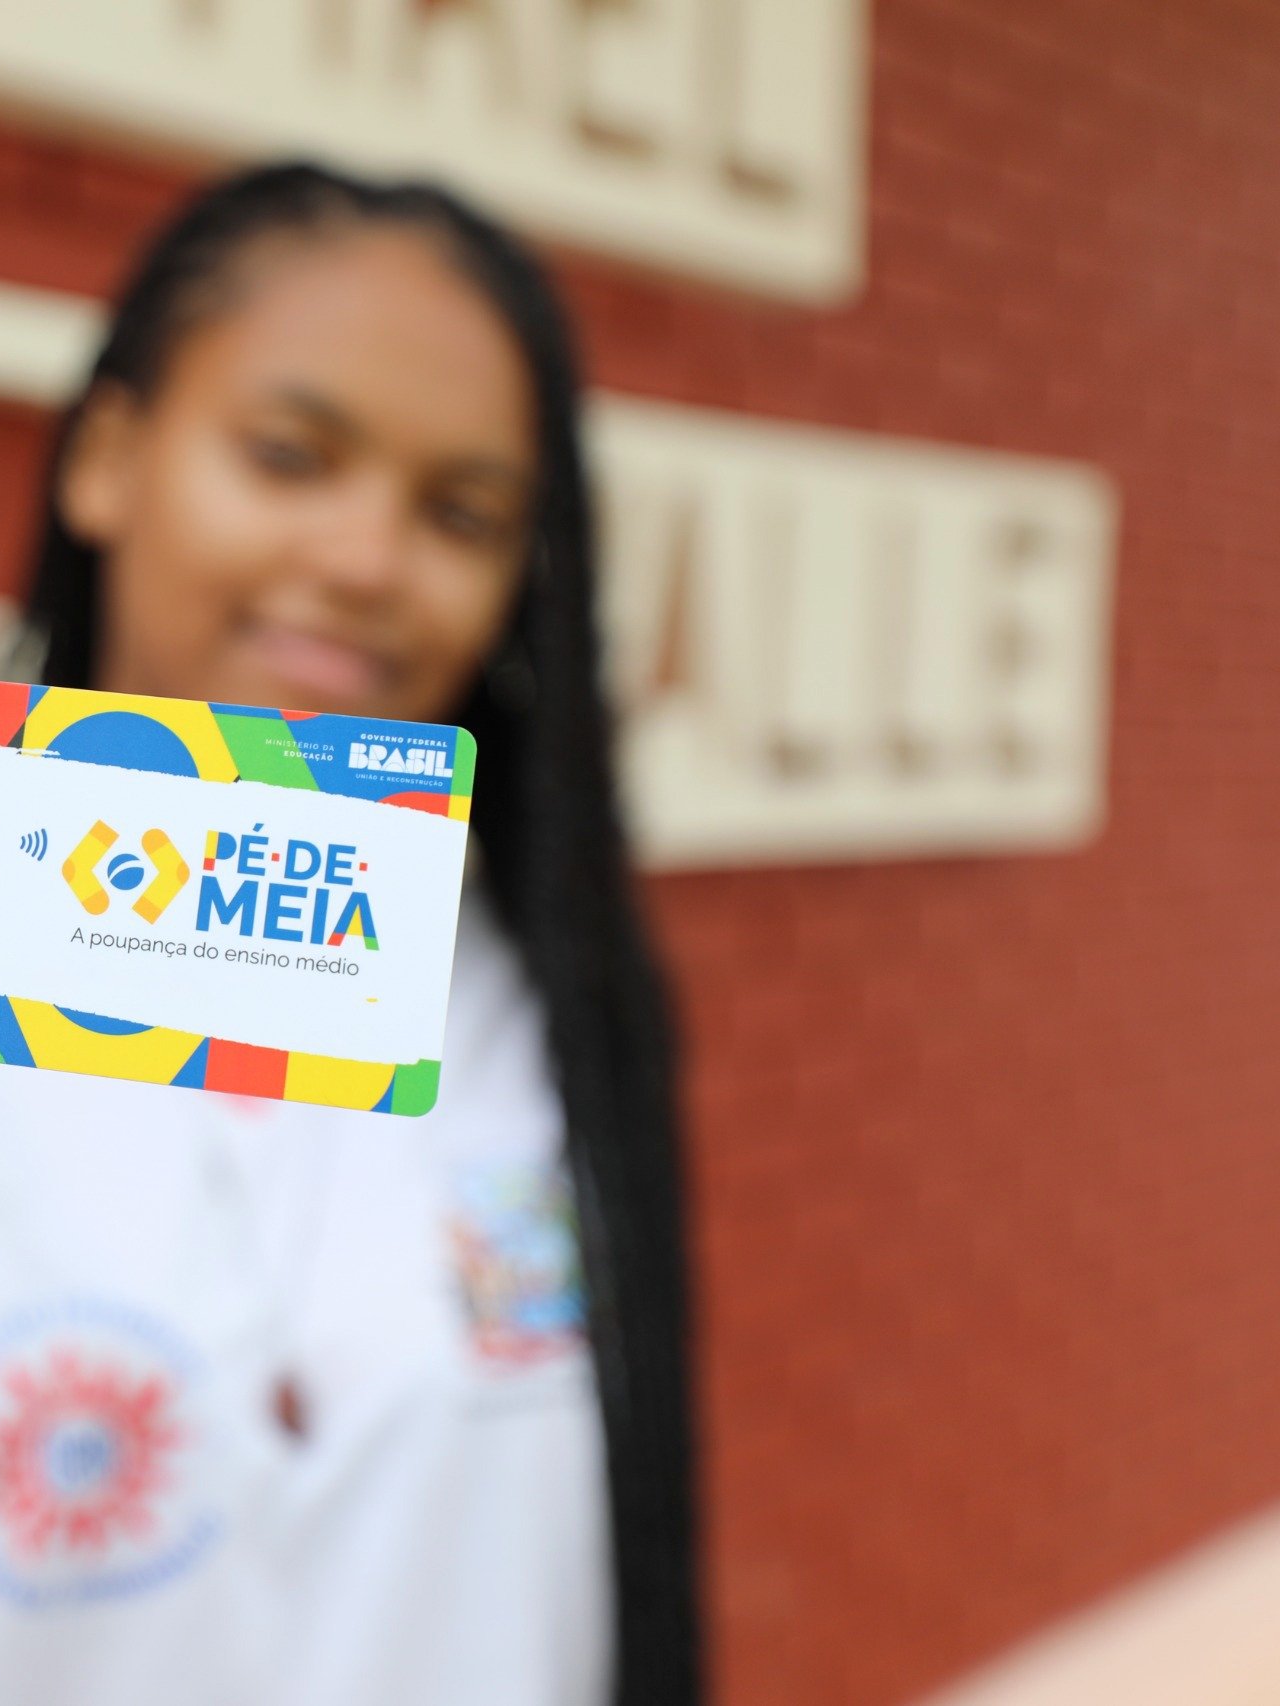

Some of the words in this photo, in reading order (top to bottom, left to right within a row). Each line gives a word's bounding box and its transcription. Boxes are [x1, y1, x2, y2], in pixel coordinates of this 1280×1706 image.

[265, 738, 319, 750] MINISTÉRIO
[360, 733, 404, 744] GOVERNO
[407, 735, 448, 748] FEDERAL
[283, 750, 334, 762] EDUCAÇÃO
[348, 742, 453, 778] BRASIL
[355, 773, 377, 781] UNIÃO
[386, 776, 443, 787] RECONSTRUÇÃO
[195, 875, 380, 951] MEIA
[71, 927, 85, 943] A
[90, 930, 187, 958] poupança
[193, 941, 219, 959] do
[225, 948, 290, 968] ensino
[296, 954, 360, 976] médio
